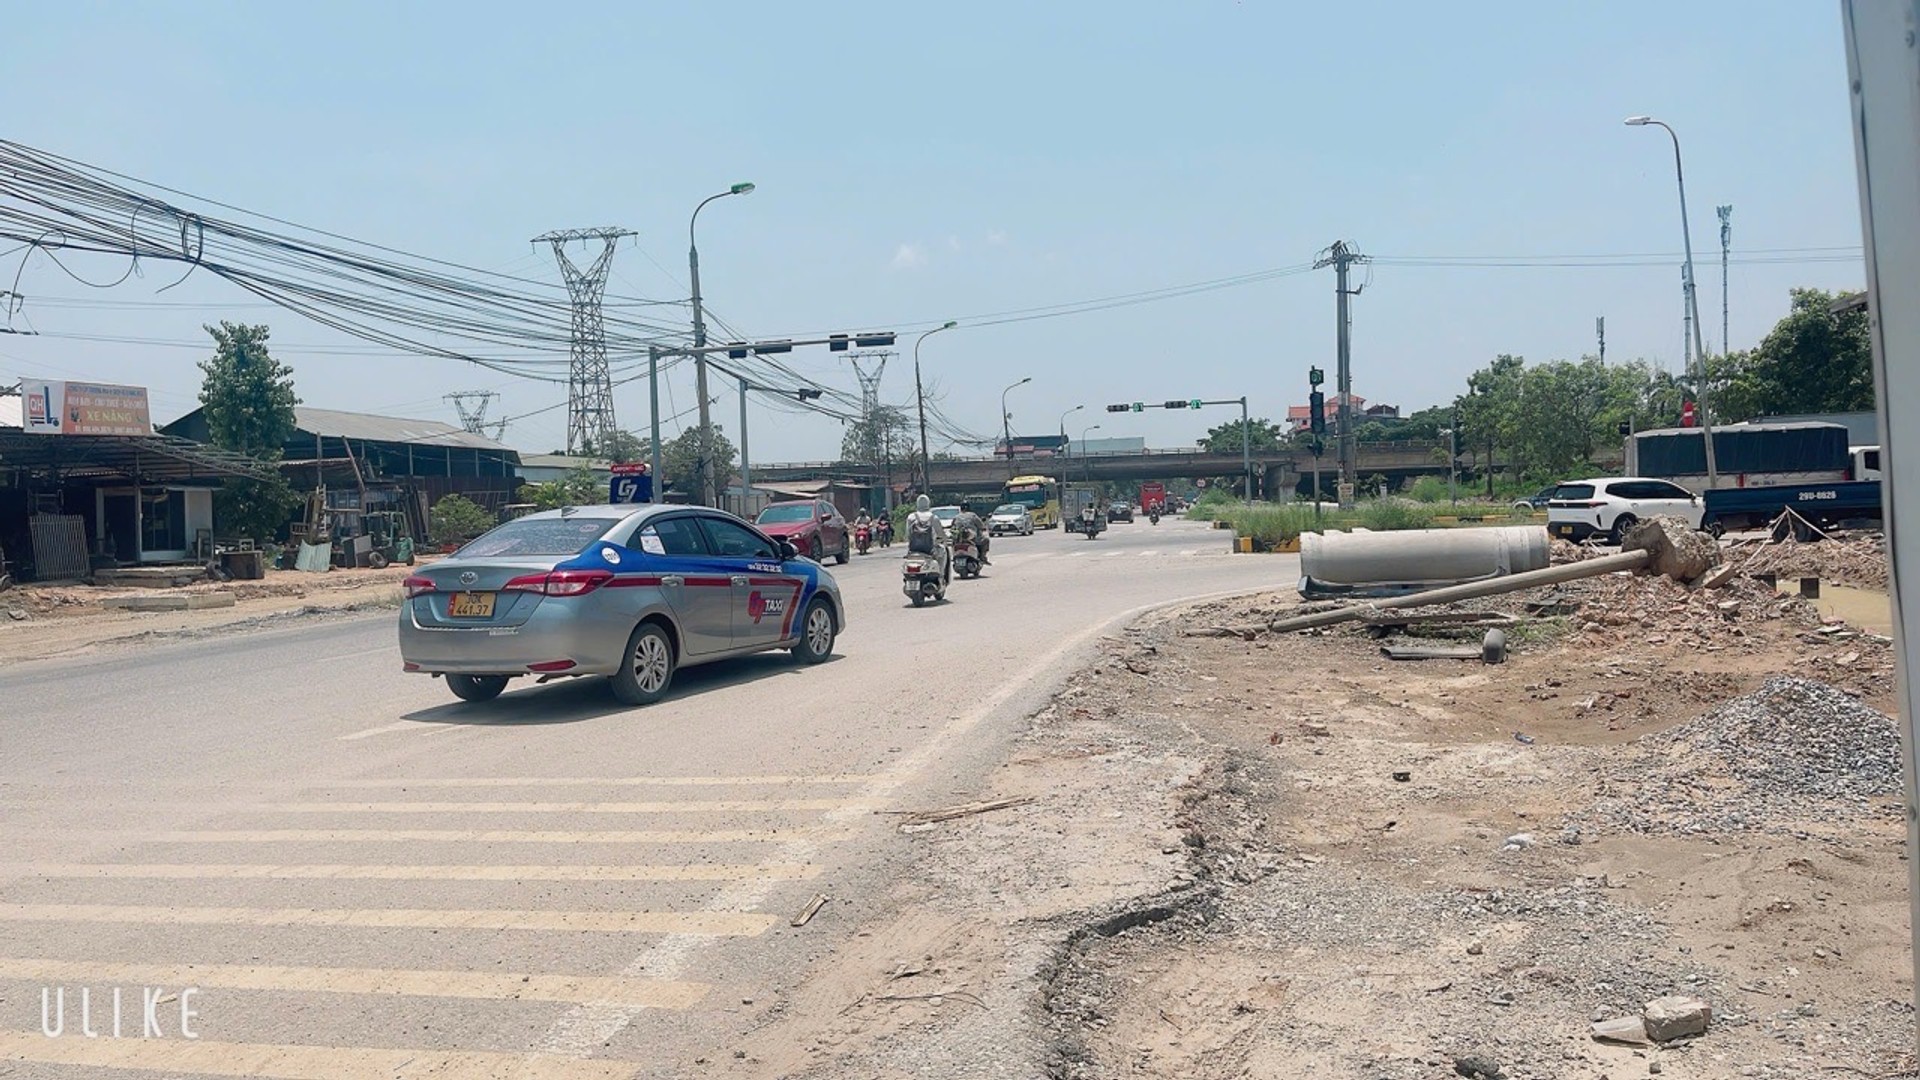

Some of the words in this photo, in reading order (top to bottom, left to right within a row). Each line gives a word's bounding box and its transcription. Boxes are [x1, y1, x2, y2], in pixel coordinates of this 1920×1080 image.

[618, 479, 638, 502] G7
[456, 604, 489, 615] 441.37
[765, 599, 783, 612] TAXI
